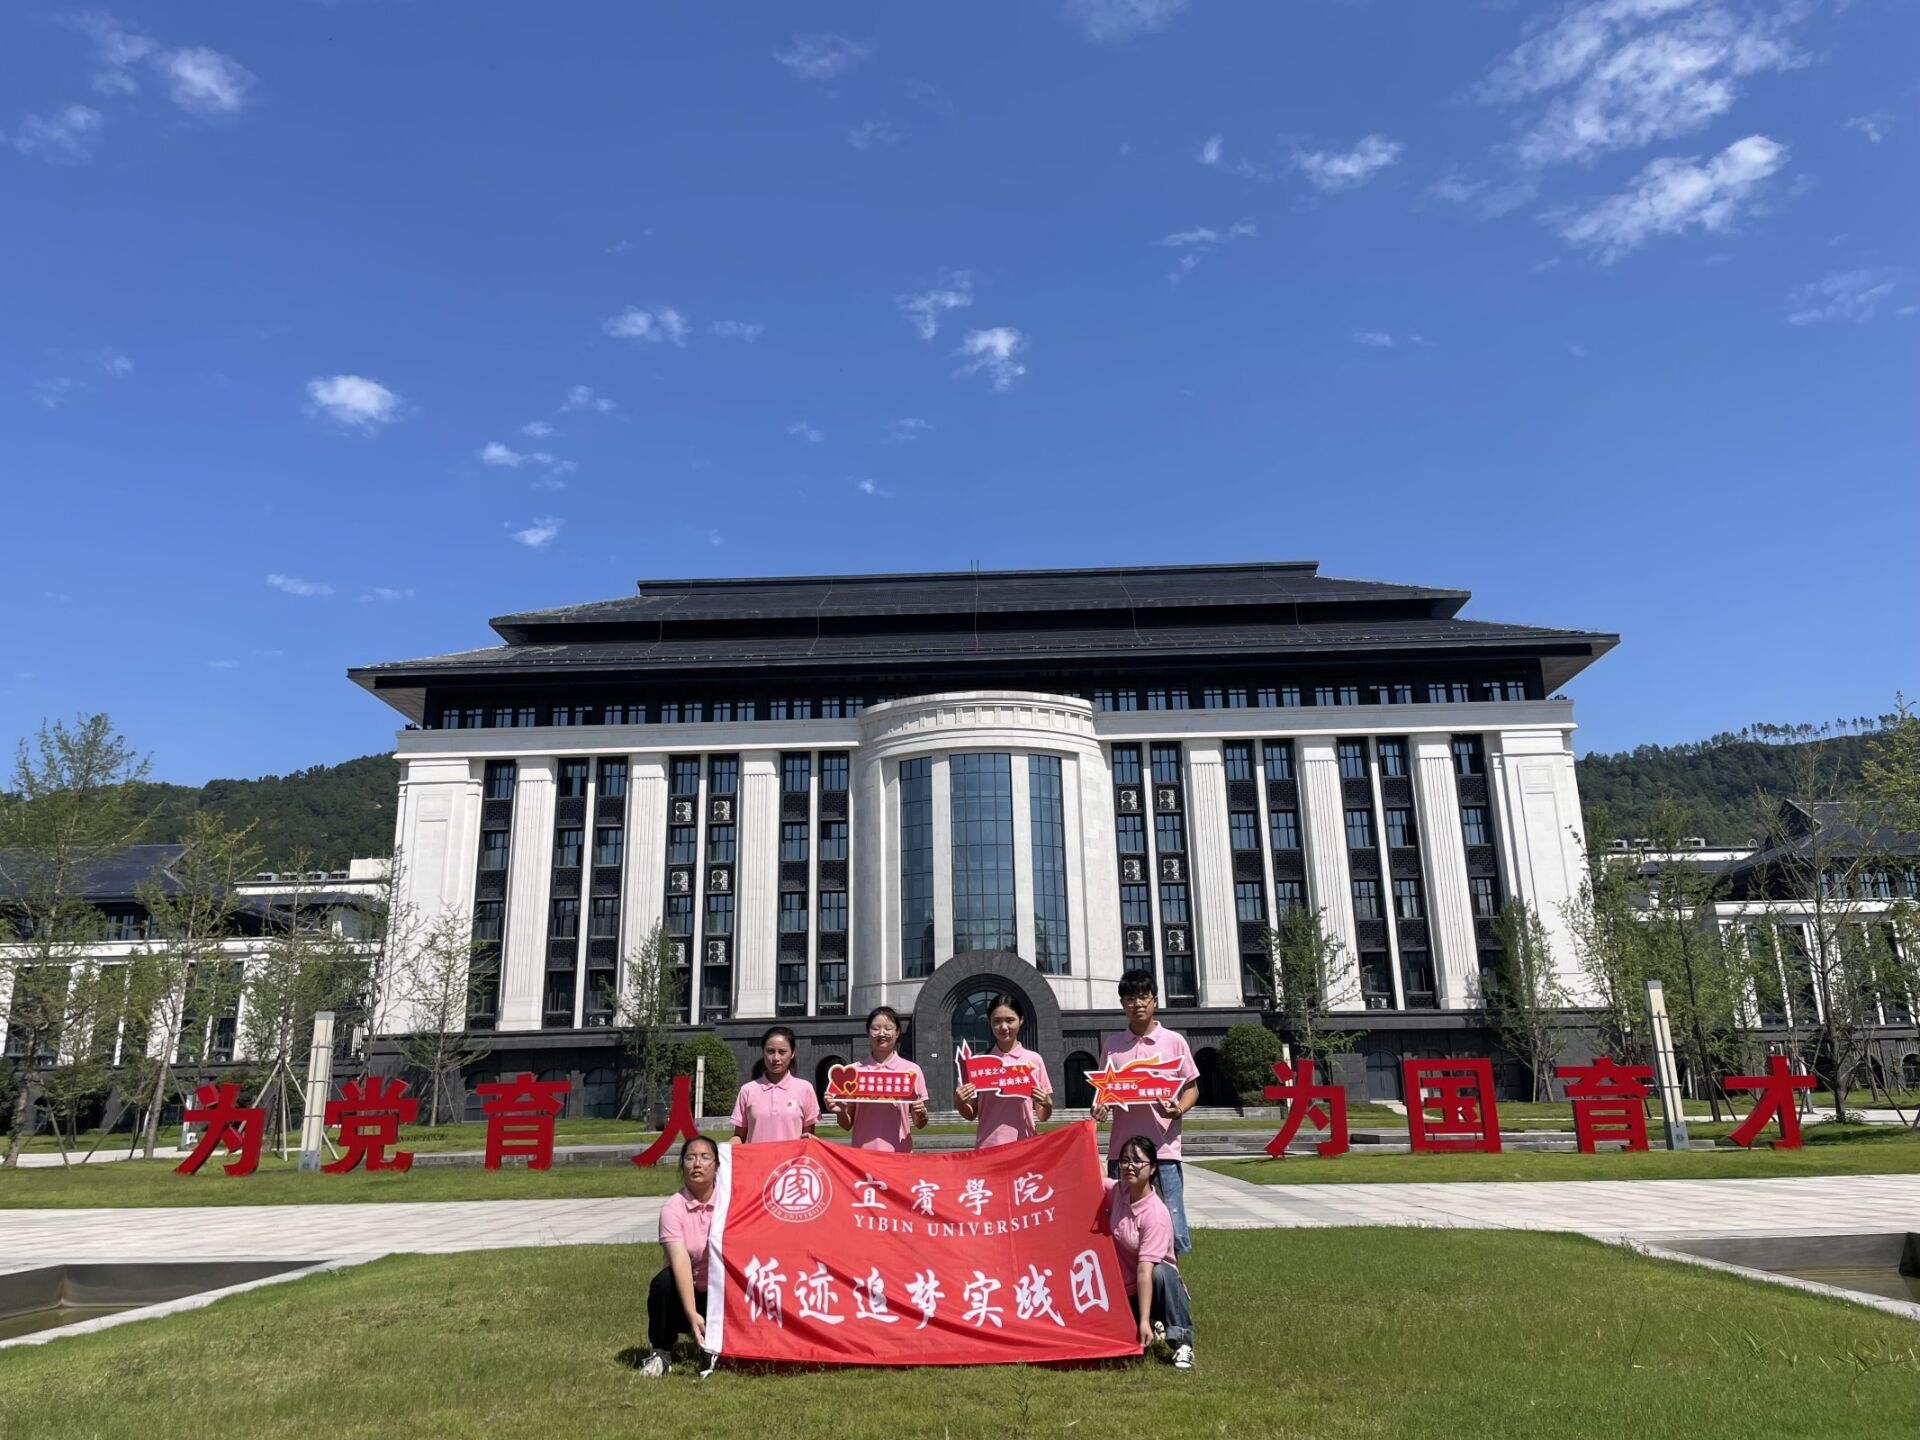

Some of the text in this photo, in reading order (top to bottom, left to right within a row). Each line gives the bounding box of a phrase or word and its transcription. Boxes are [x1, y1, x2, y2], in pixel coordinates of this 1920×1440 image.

[991, 1076, 1030, 1087] 一起向未来
[1106, 1083, 1138, 1091] 不忘初心
[173, 1056, 1817, 1177] 为党育人 为国育才
[854, 1207, 1056, 1237] YIBIN UNIVERSITY
[744, 1249, 1109, 1329] 循迹追梦实践团
